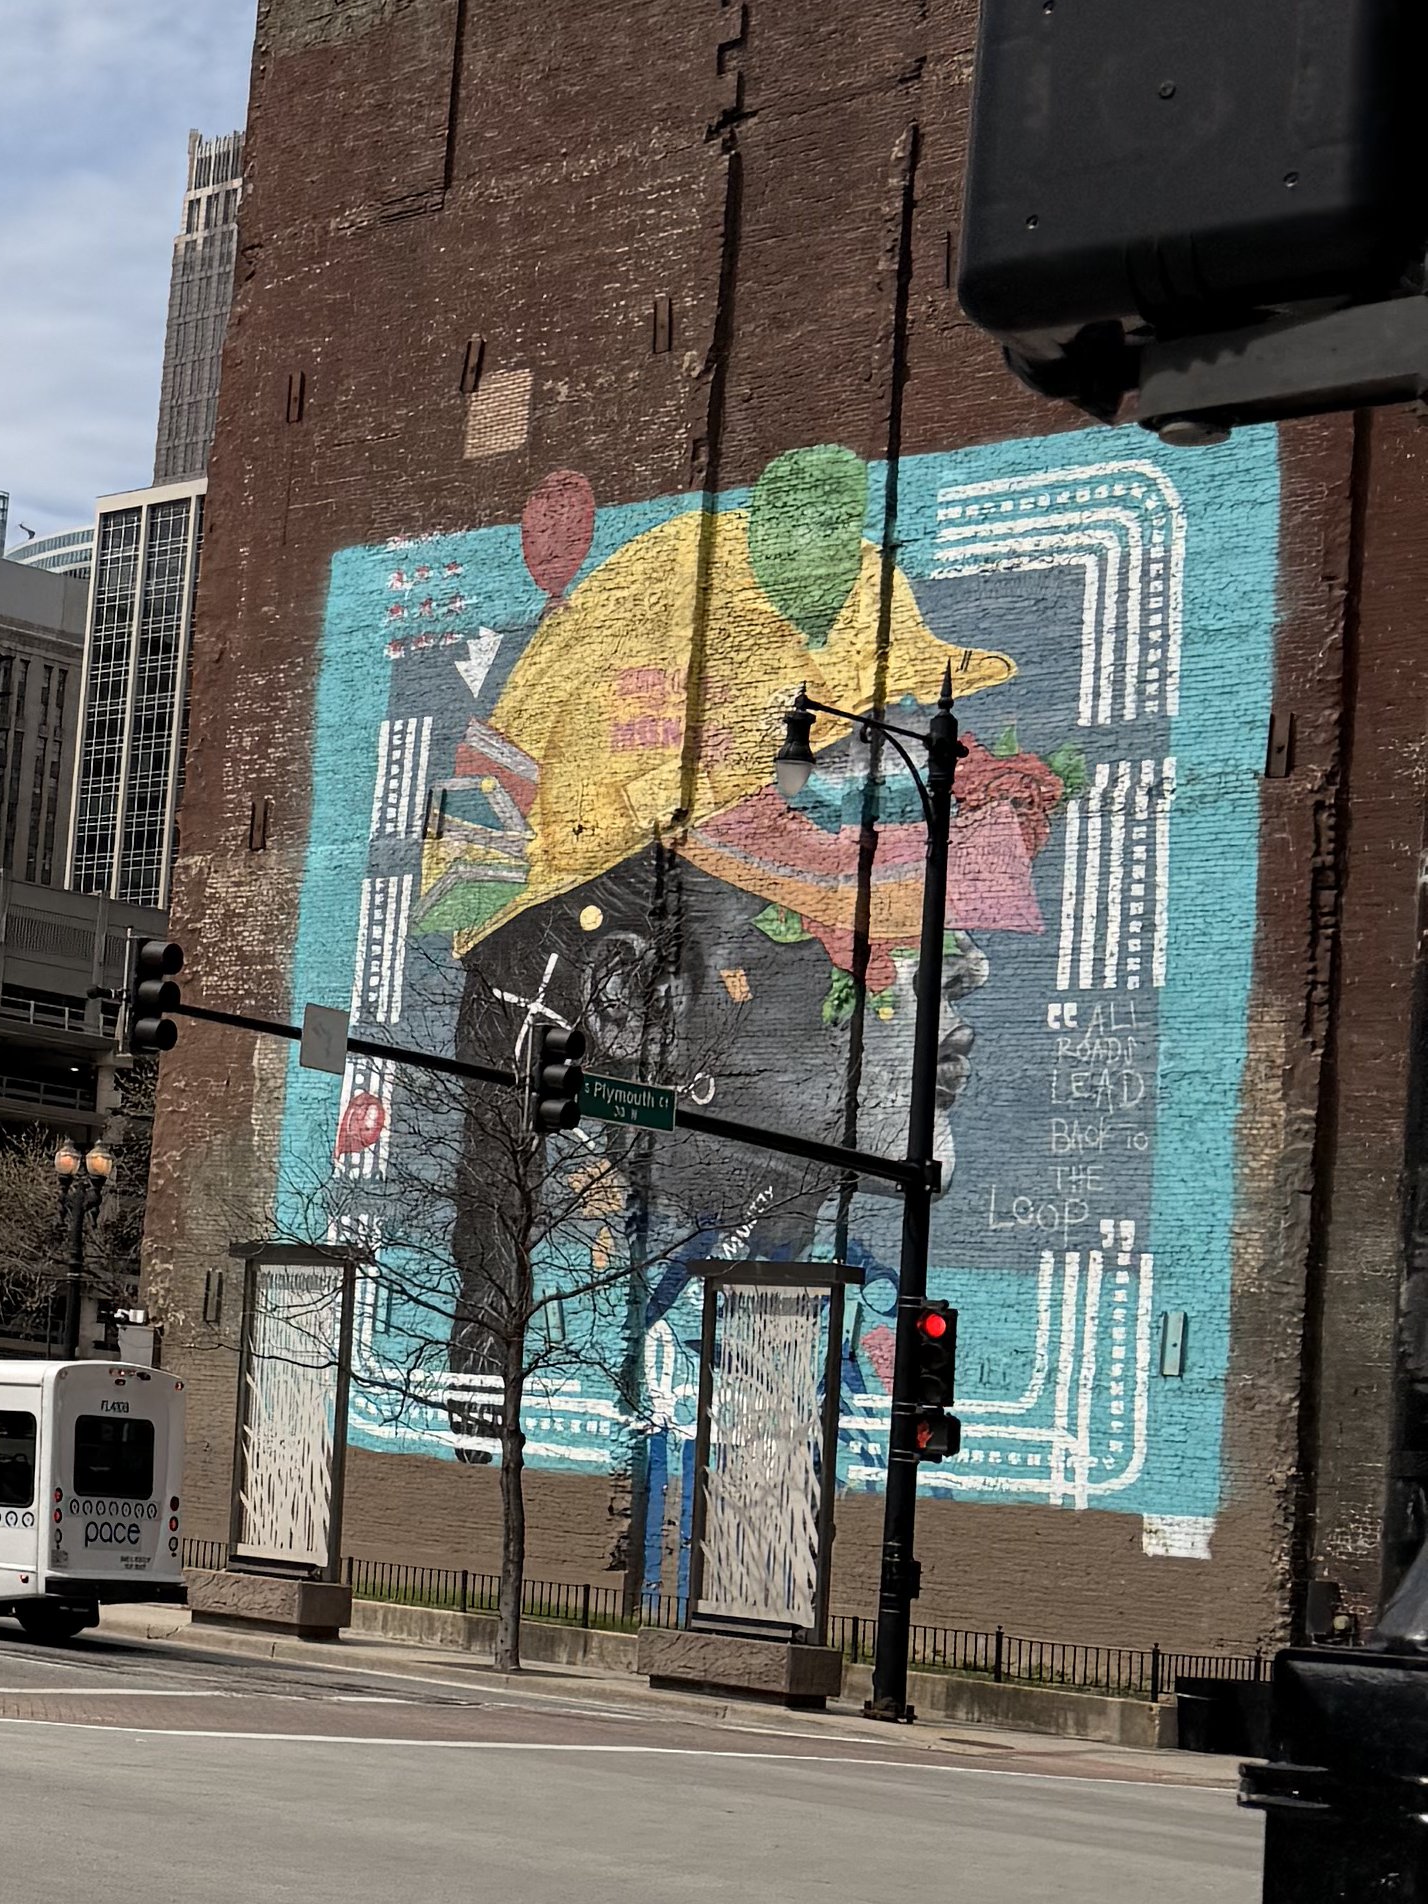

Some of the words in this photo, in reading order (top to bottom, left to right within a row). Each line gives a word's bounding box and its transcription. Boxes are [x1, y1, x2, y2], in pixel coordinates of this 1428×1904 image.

[1056, 1037, 1138, 1066] ROADS
[593, 1081, 655, 1108] Plymouth
[1051, 1068, 1145, 1115] LEAD
[1050, 1116, 1111, 1155] BACK
[1117, 1123, 1149, 1151] TO
[1048, 1164, 1105, 1193] THE
[84, 1520, 141, 1548] pace
